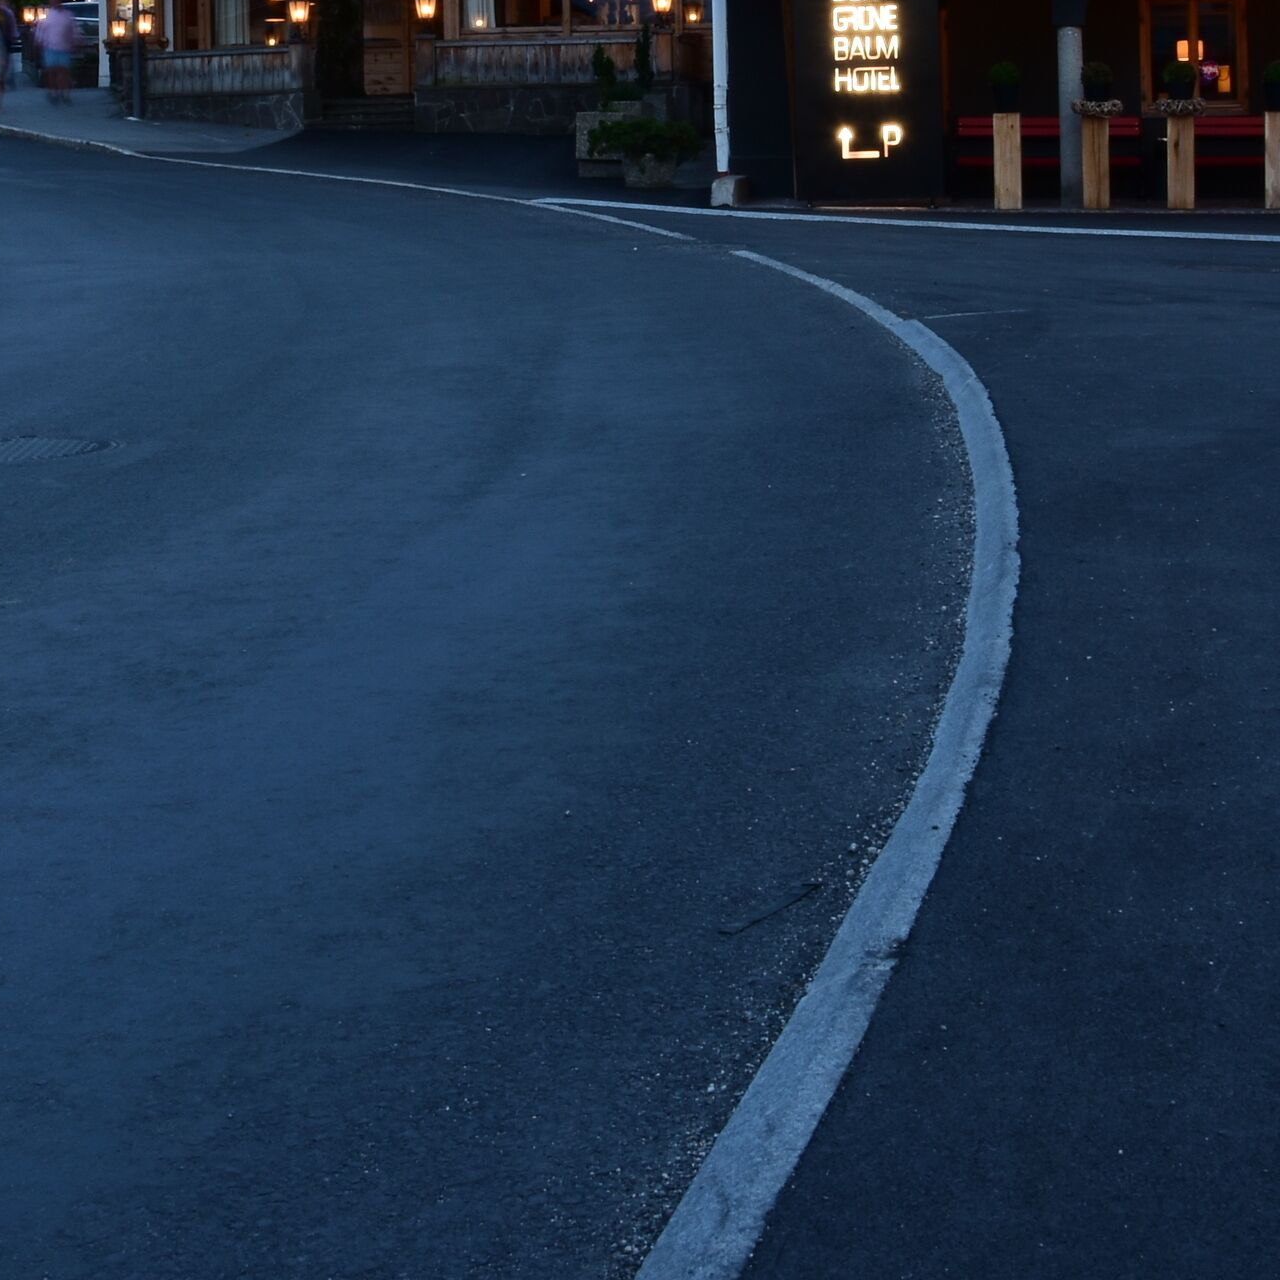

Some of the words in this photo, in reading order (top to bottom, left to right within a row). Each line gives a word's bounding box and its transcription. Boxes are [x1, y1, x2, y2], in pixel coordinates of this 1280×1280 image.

[833, 35, 898, 61] BAUM
[834, 66, 900, 92] HOTEL
[882, 124, 901, 157] P
